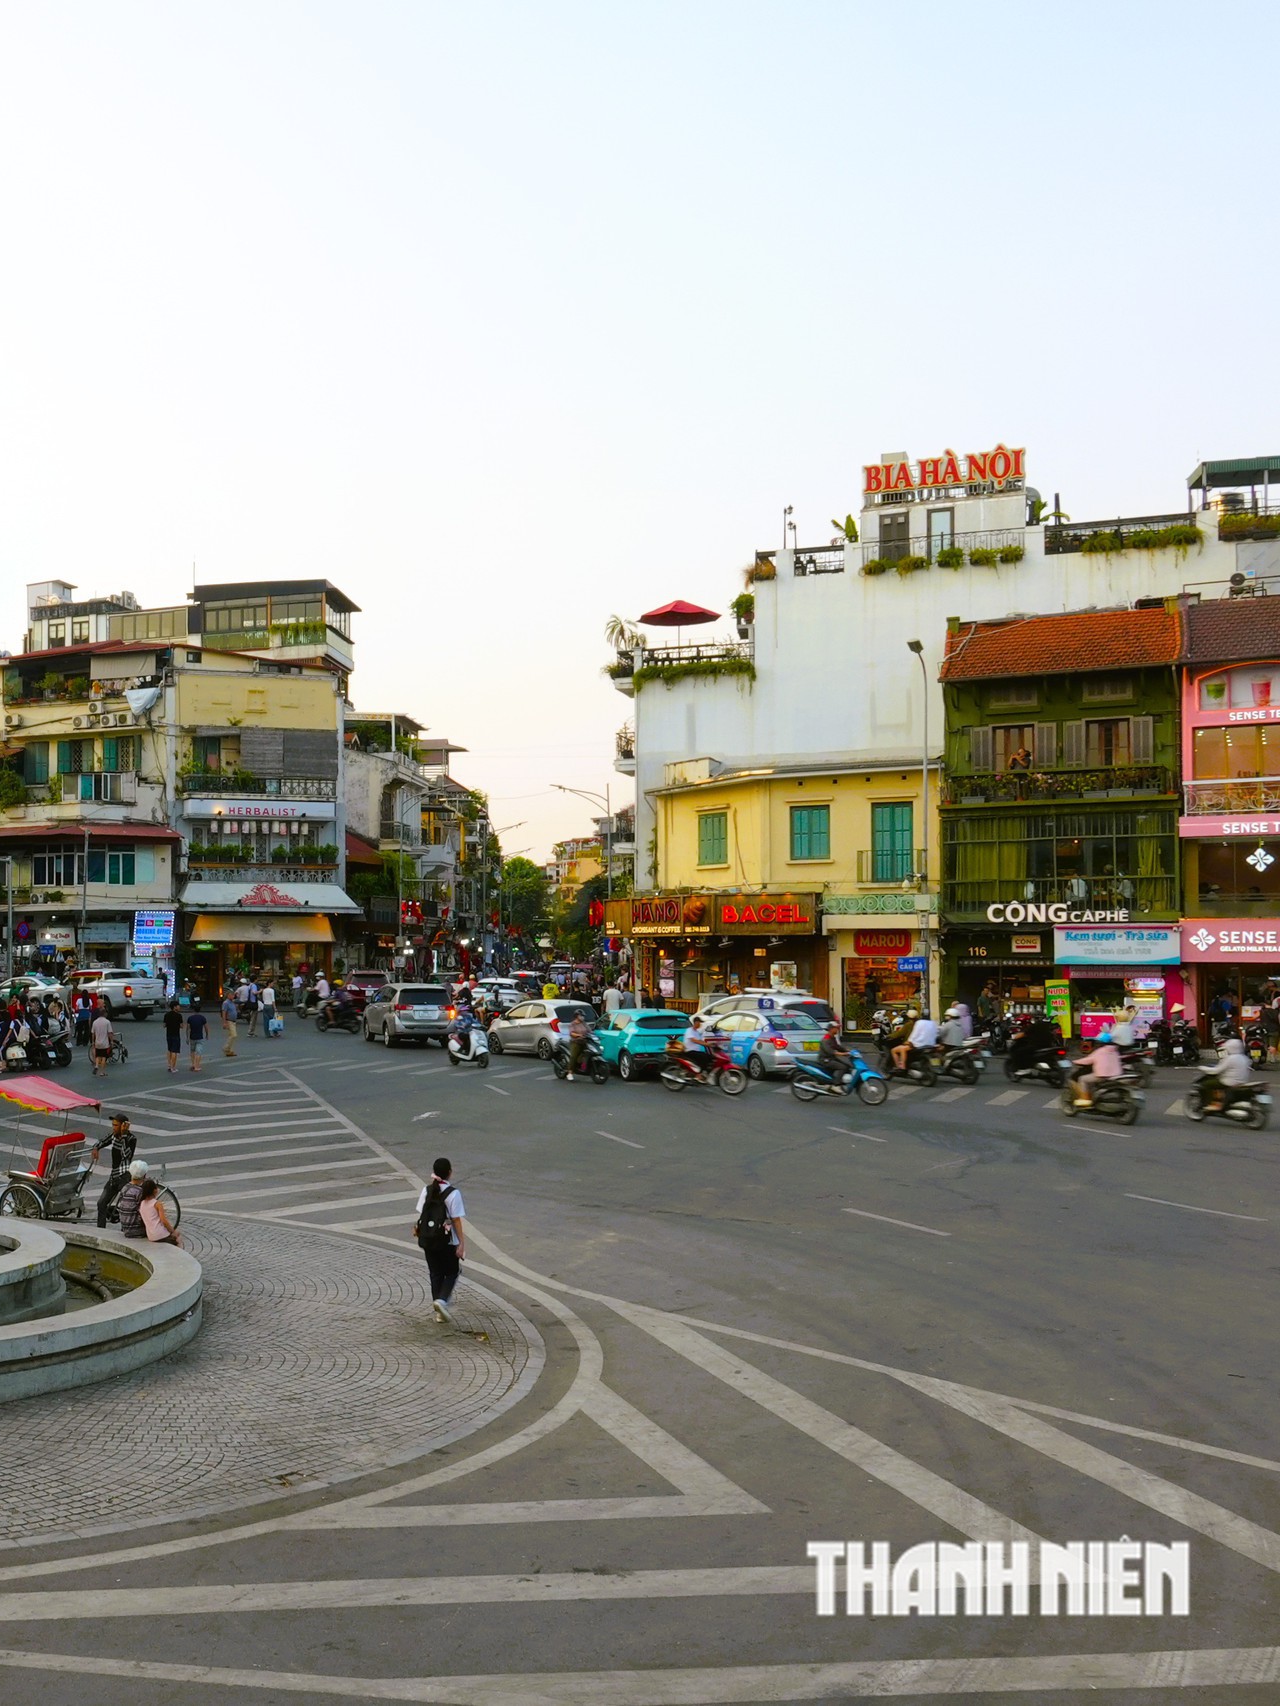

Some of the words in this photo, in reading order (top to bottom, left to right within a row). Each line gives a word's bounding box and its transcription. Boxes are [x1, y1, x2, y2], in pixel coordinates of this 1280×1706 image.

[864, 461, 915, 494] BIA
[917, 449, 963, 487] HÀ
[966, 443, 1026, 489] NỘI
[1229, 710, 1267, 721] SENSE
[228, 806, 297, 817] HERBALIST
[1222, 822, 1269, 835] SENSE
[721, 904, 810, 924] BAGEL
[986, 900, 1068, 927] CỘNG
[631, 926, 657, 934] CROISSANT
[662, 925, 681, 933] COFFEE
[859, 935, 905, 947] MAROU
[1065, 931, 1089, 941] Kem
[1219, 931, 1277, 944] SENSE
[967, 946, 987, 957] 116
